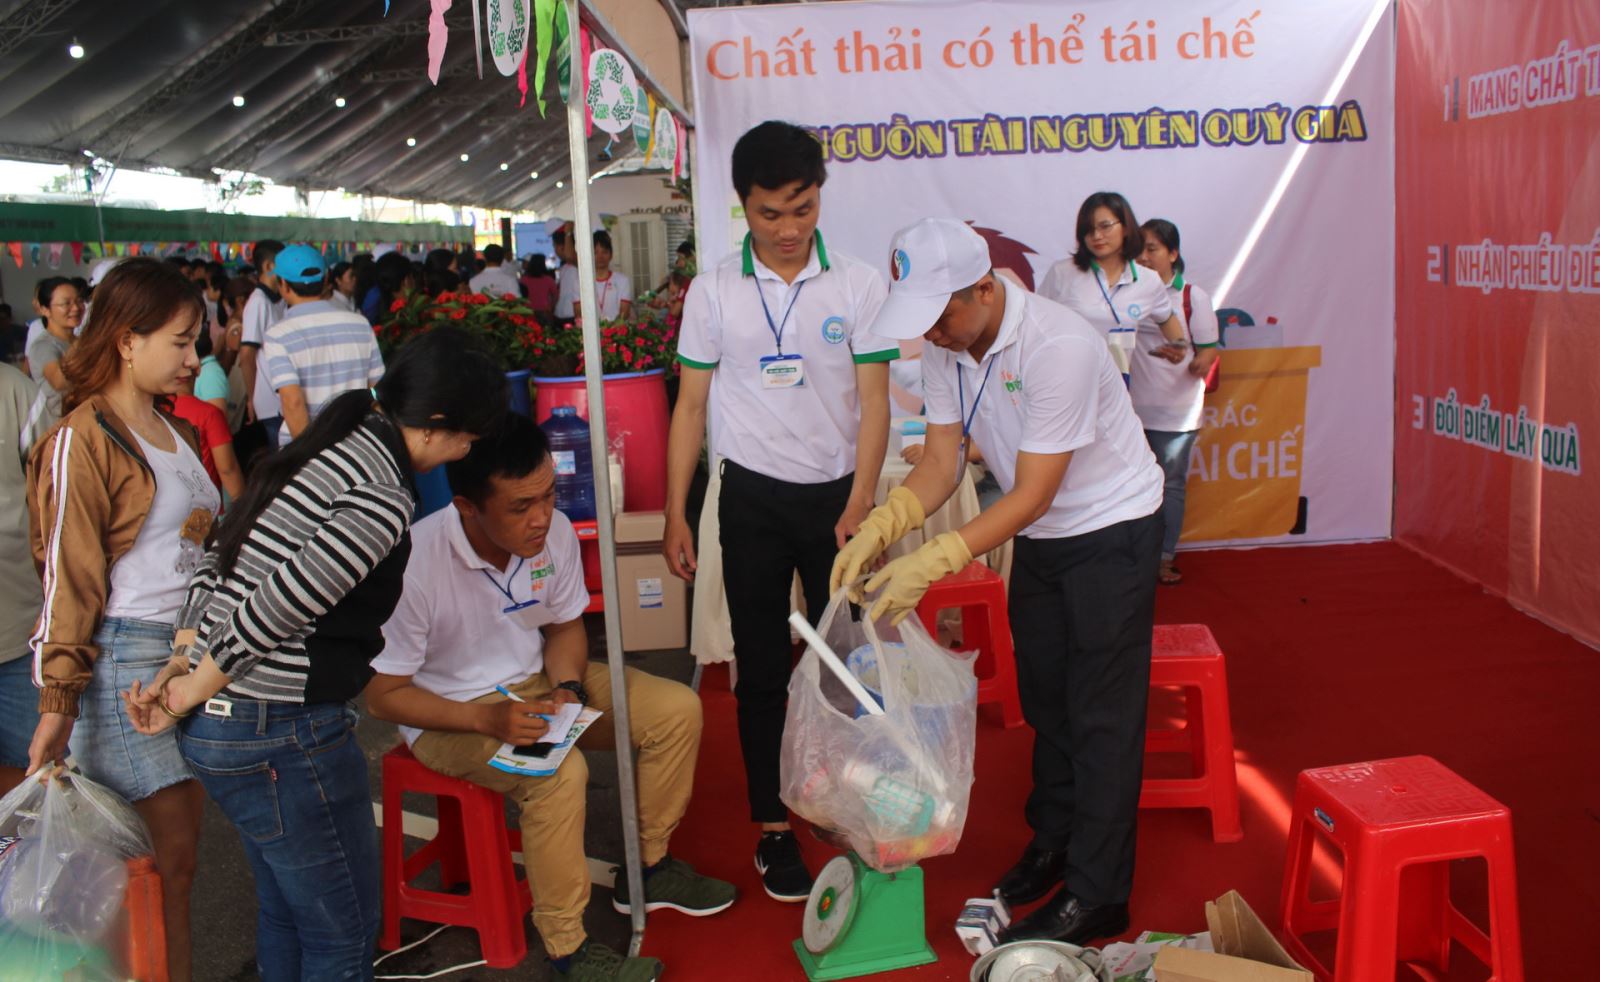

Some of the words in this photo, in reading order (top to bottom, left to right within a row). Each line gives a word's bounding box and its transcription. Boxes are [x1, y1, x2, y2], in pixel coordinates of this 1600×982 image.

[706, 27, 817, 80] Chất
[833, 26, 922, 74] thải
[943, 26, 994, 69] có
[1010, 12, 1085, 66] thể
[1100, 19, 1157, 63] tái
[1177, 9, 1261, 60] chế
[1469, 67, 1519, 117] MANG
[1525, 42, 1581, 106] CHẤT
[950, 113, 1026, 156] TÀI
[1030, 107, 1198, 153] NGUYÊN
[1202, 103, 1291, 146] QUÝ
[1294, 100, 1367, 143] GIÁ
[1427, 246, 1441, 281] 2
[1456, 240, 1504, 293] NHẬN
[1507, 233, 1564, 290] PHIẾU
[1202, 400, 1257, 428] RÁC
[1412, 395, 1424, 430] 3
[1434, 388, 1459, 437] ĐỔI
[1463, 395, 1501, 450] ĐIỂM
[1504, 406, 1537, 459] LẤY
[1540, 423, 1580, 474] QUÀ
[1227, 424, 1301, 481] CHẾ
